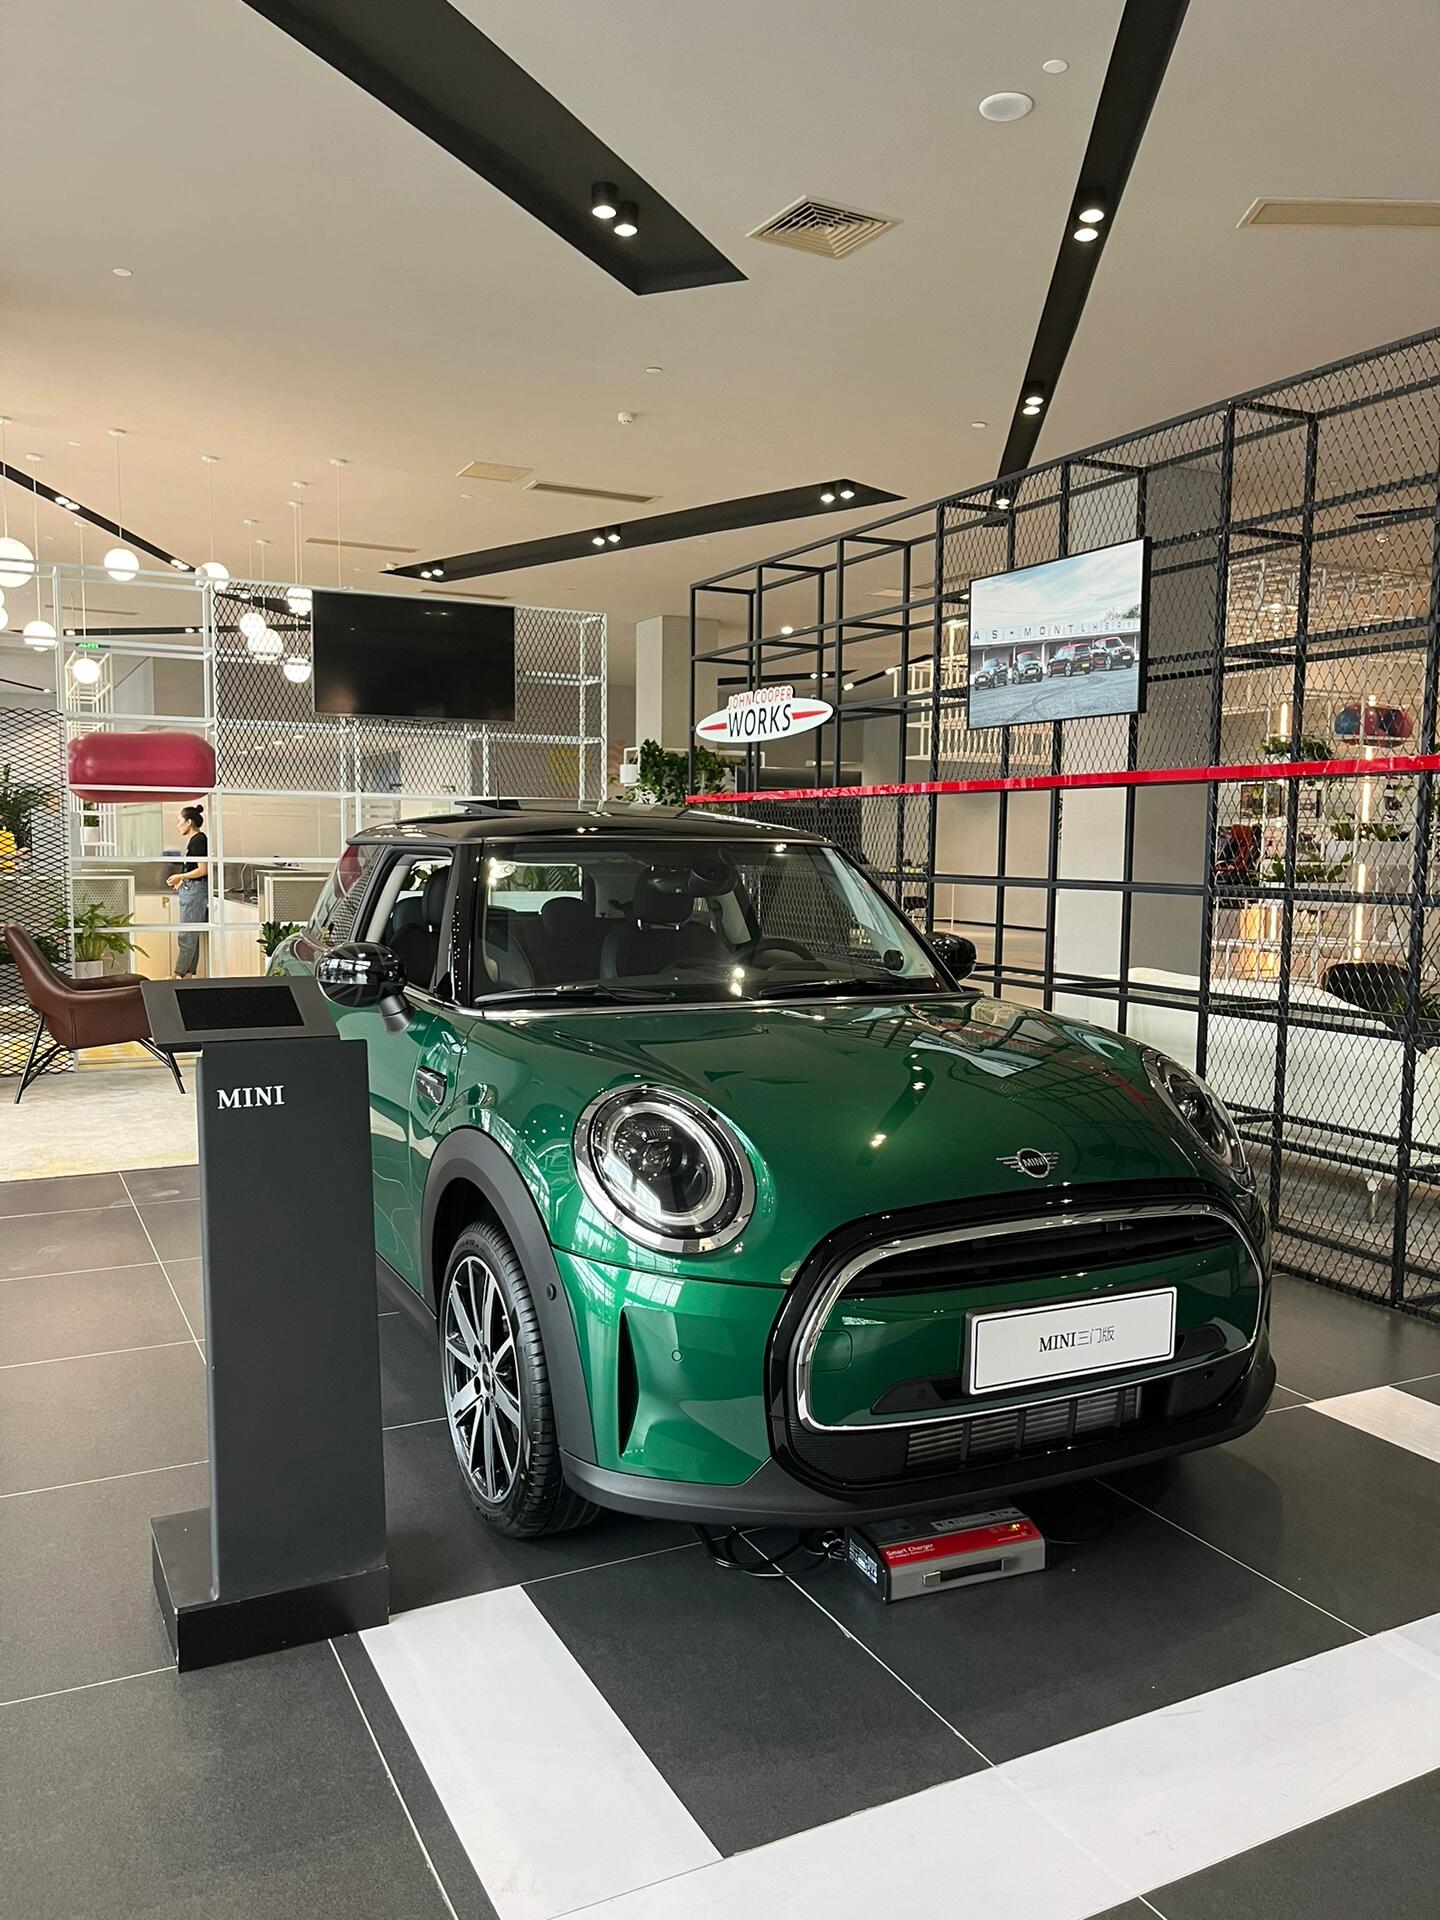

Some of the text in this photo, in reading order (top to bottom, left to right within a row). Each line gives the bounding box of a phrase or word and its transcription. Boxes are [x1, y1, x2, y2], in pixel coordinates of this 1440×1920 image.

[728, 687, 793, 711] JOHN COOPER
[728, 704, 791, 737] WORKS
[216, 1085, 285, 1109] MINI
[1022, 1157, 1047, 1167] MINI
